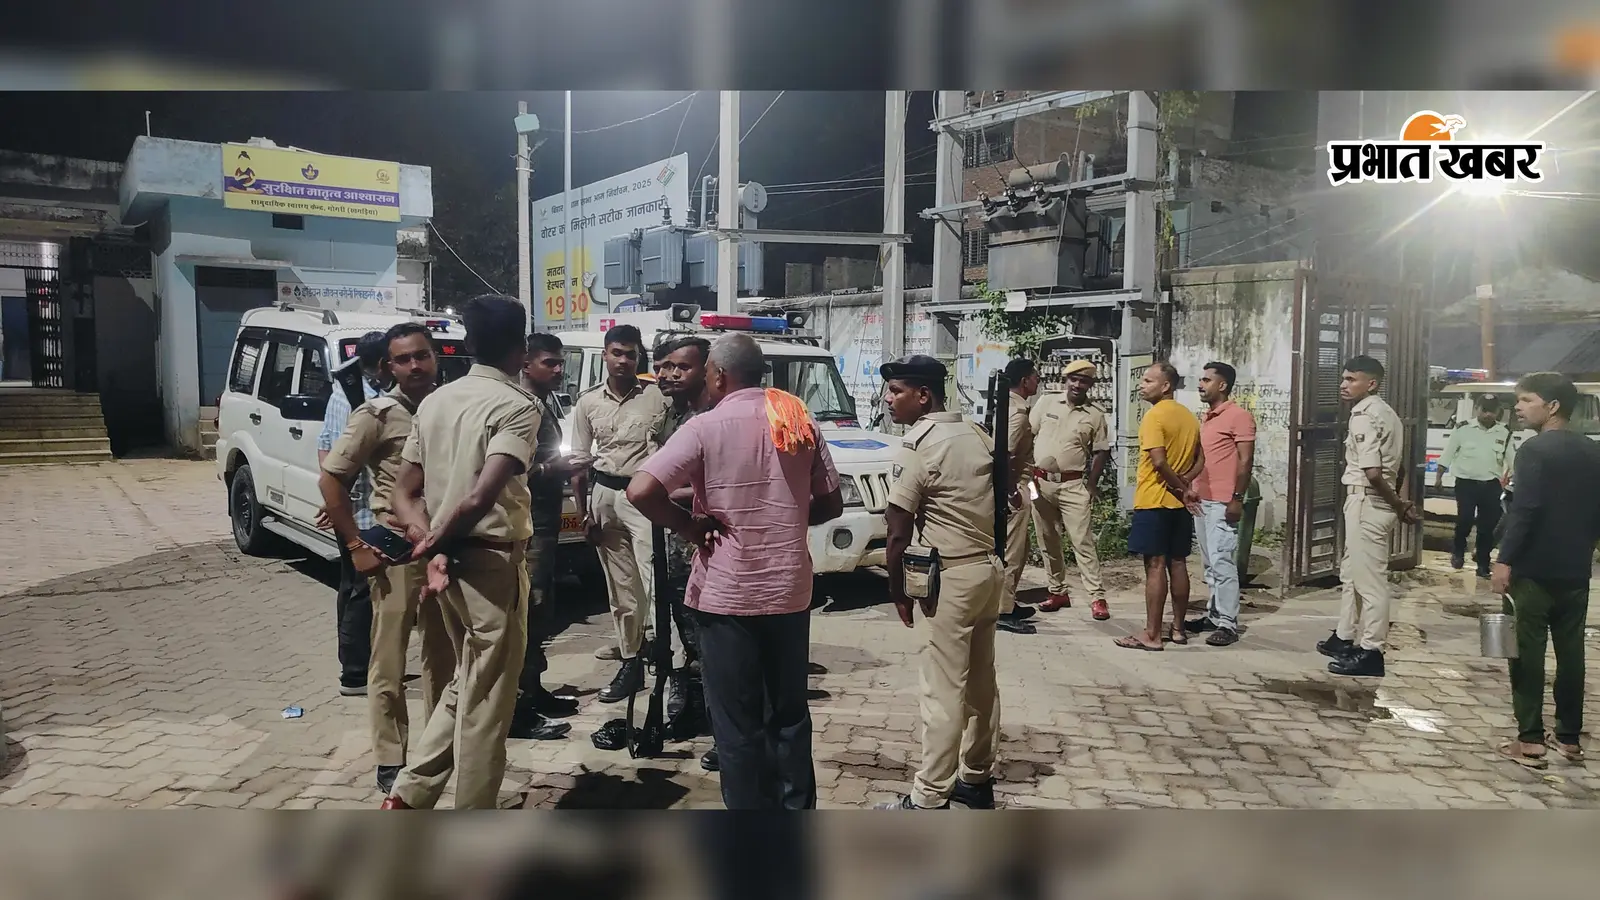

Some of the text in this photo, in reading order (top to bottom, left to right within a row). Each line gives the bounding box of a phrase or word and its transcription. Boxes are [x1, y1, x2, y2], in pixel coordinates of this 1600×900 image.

[261, 183, 394, 203] सुरक्षित मातृत्व आश्वासन
[551, 204, 564, 214] बिहार
[594, 192, 605, 202] आम
[632, 179, 652, 191] 2025
[540, 225, 557, 239] वोटर
[571, 213, 596, 232] मिलेगी
[598, 208, 623, 225] सटीक
[546, 292, 589, 316] 1950
